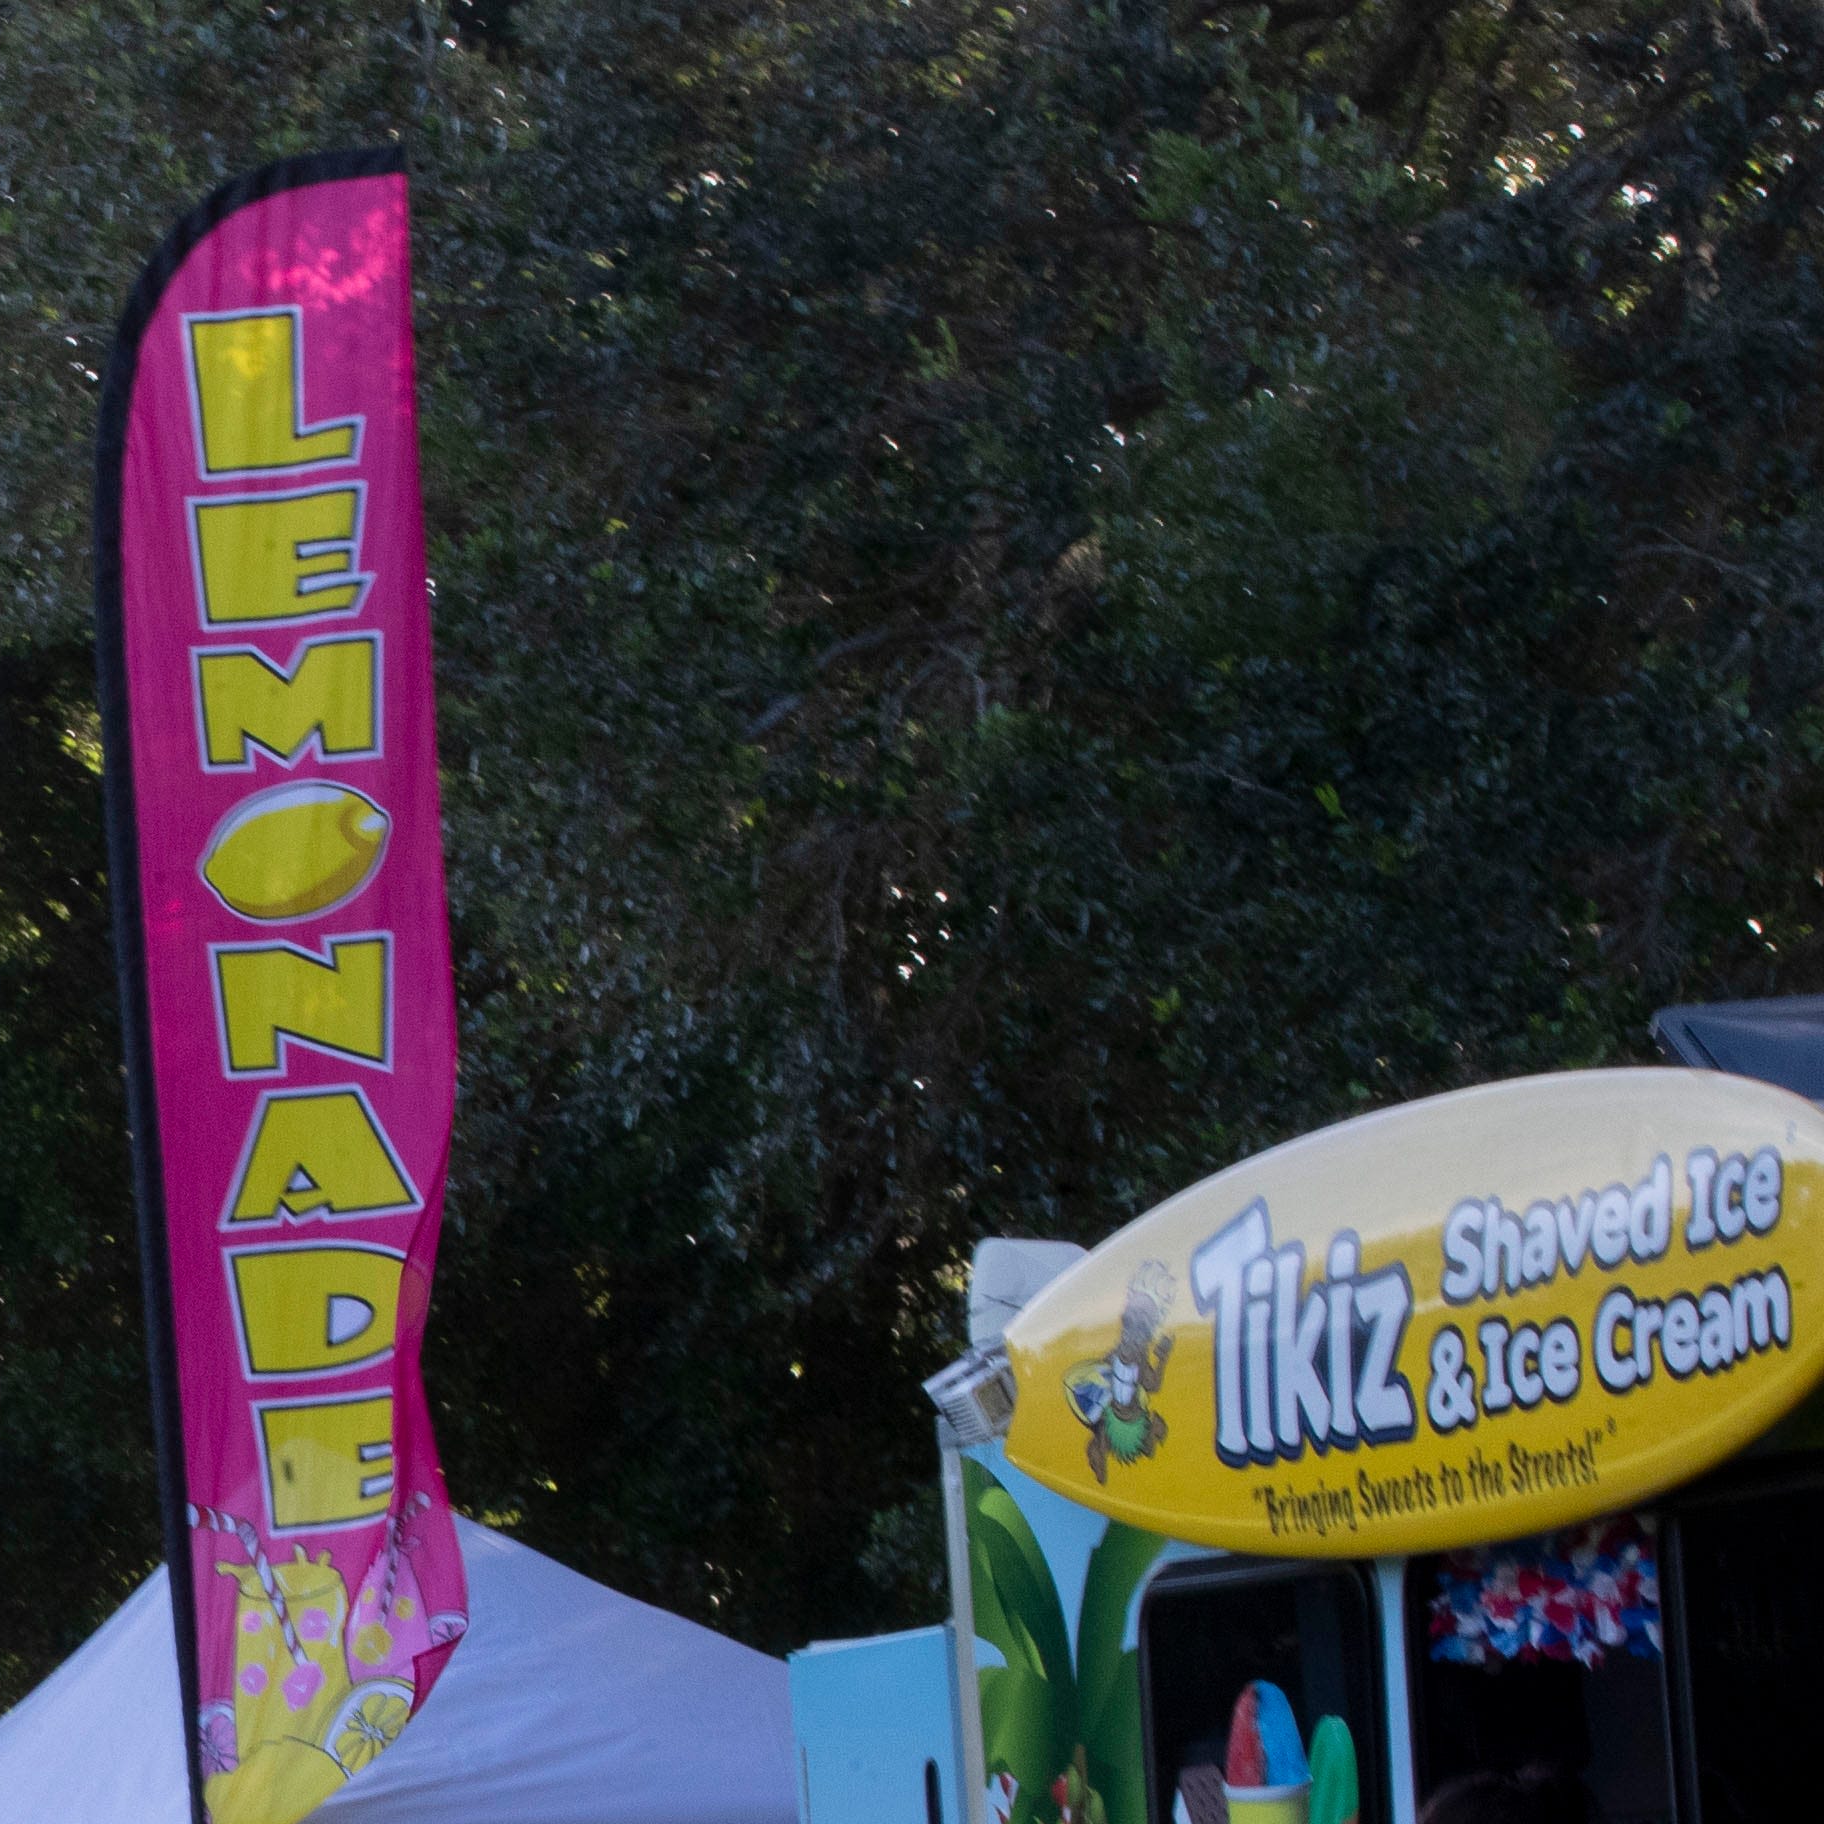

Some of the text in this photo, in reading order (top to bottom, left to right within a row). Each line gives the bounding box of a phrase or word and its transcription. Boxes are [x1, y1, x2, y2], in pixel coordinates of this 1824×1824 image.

[1443, 1146, 1783, 1304] Shaved Ice
[1192, 1197, 1416, 1464] Tikiz
[1427, 1267, 1792, 1432] & Ice Cream
[1358, 1466, 1437, 1519] Sweets
[1441, 1461, 1464, 1505] to
[1467, 1448, 1504, 1501] the
